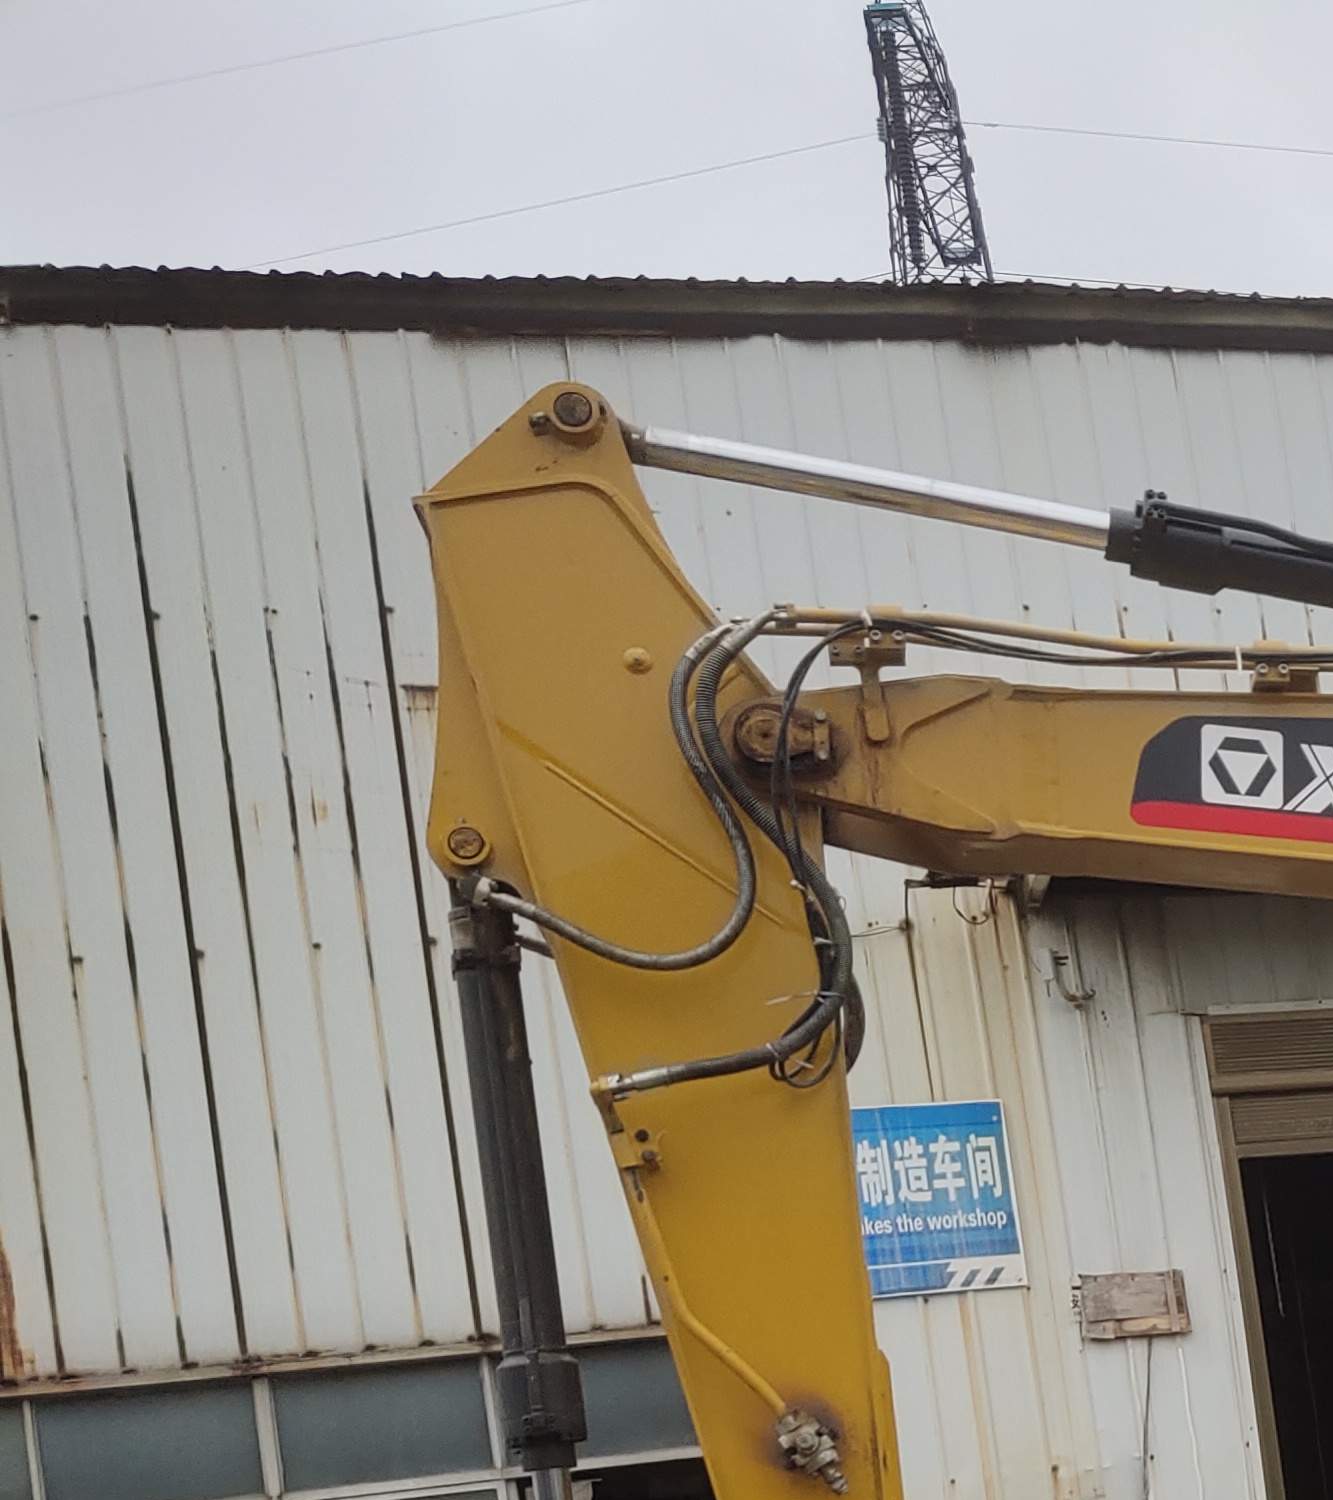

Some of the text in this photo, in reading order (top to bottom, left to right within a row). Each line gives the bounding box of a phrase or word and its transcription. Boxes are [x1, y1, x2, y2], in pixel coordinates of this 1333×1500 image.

[856, 1133, 1003, 1207] 制造车间
[896, 1213, 924, 1232] the
[927, 1208, 1007, 1231] workshop
